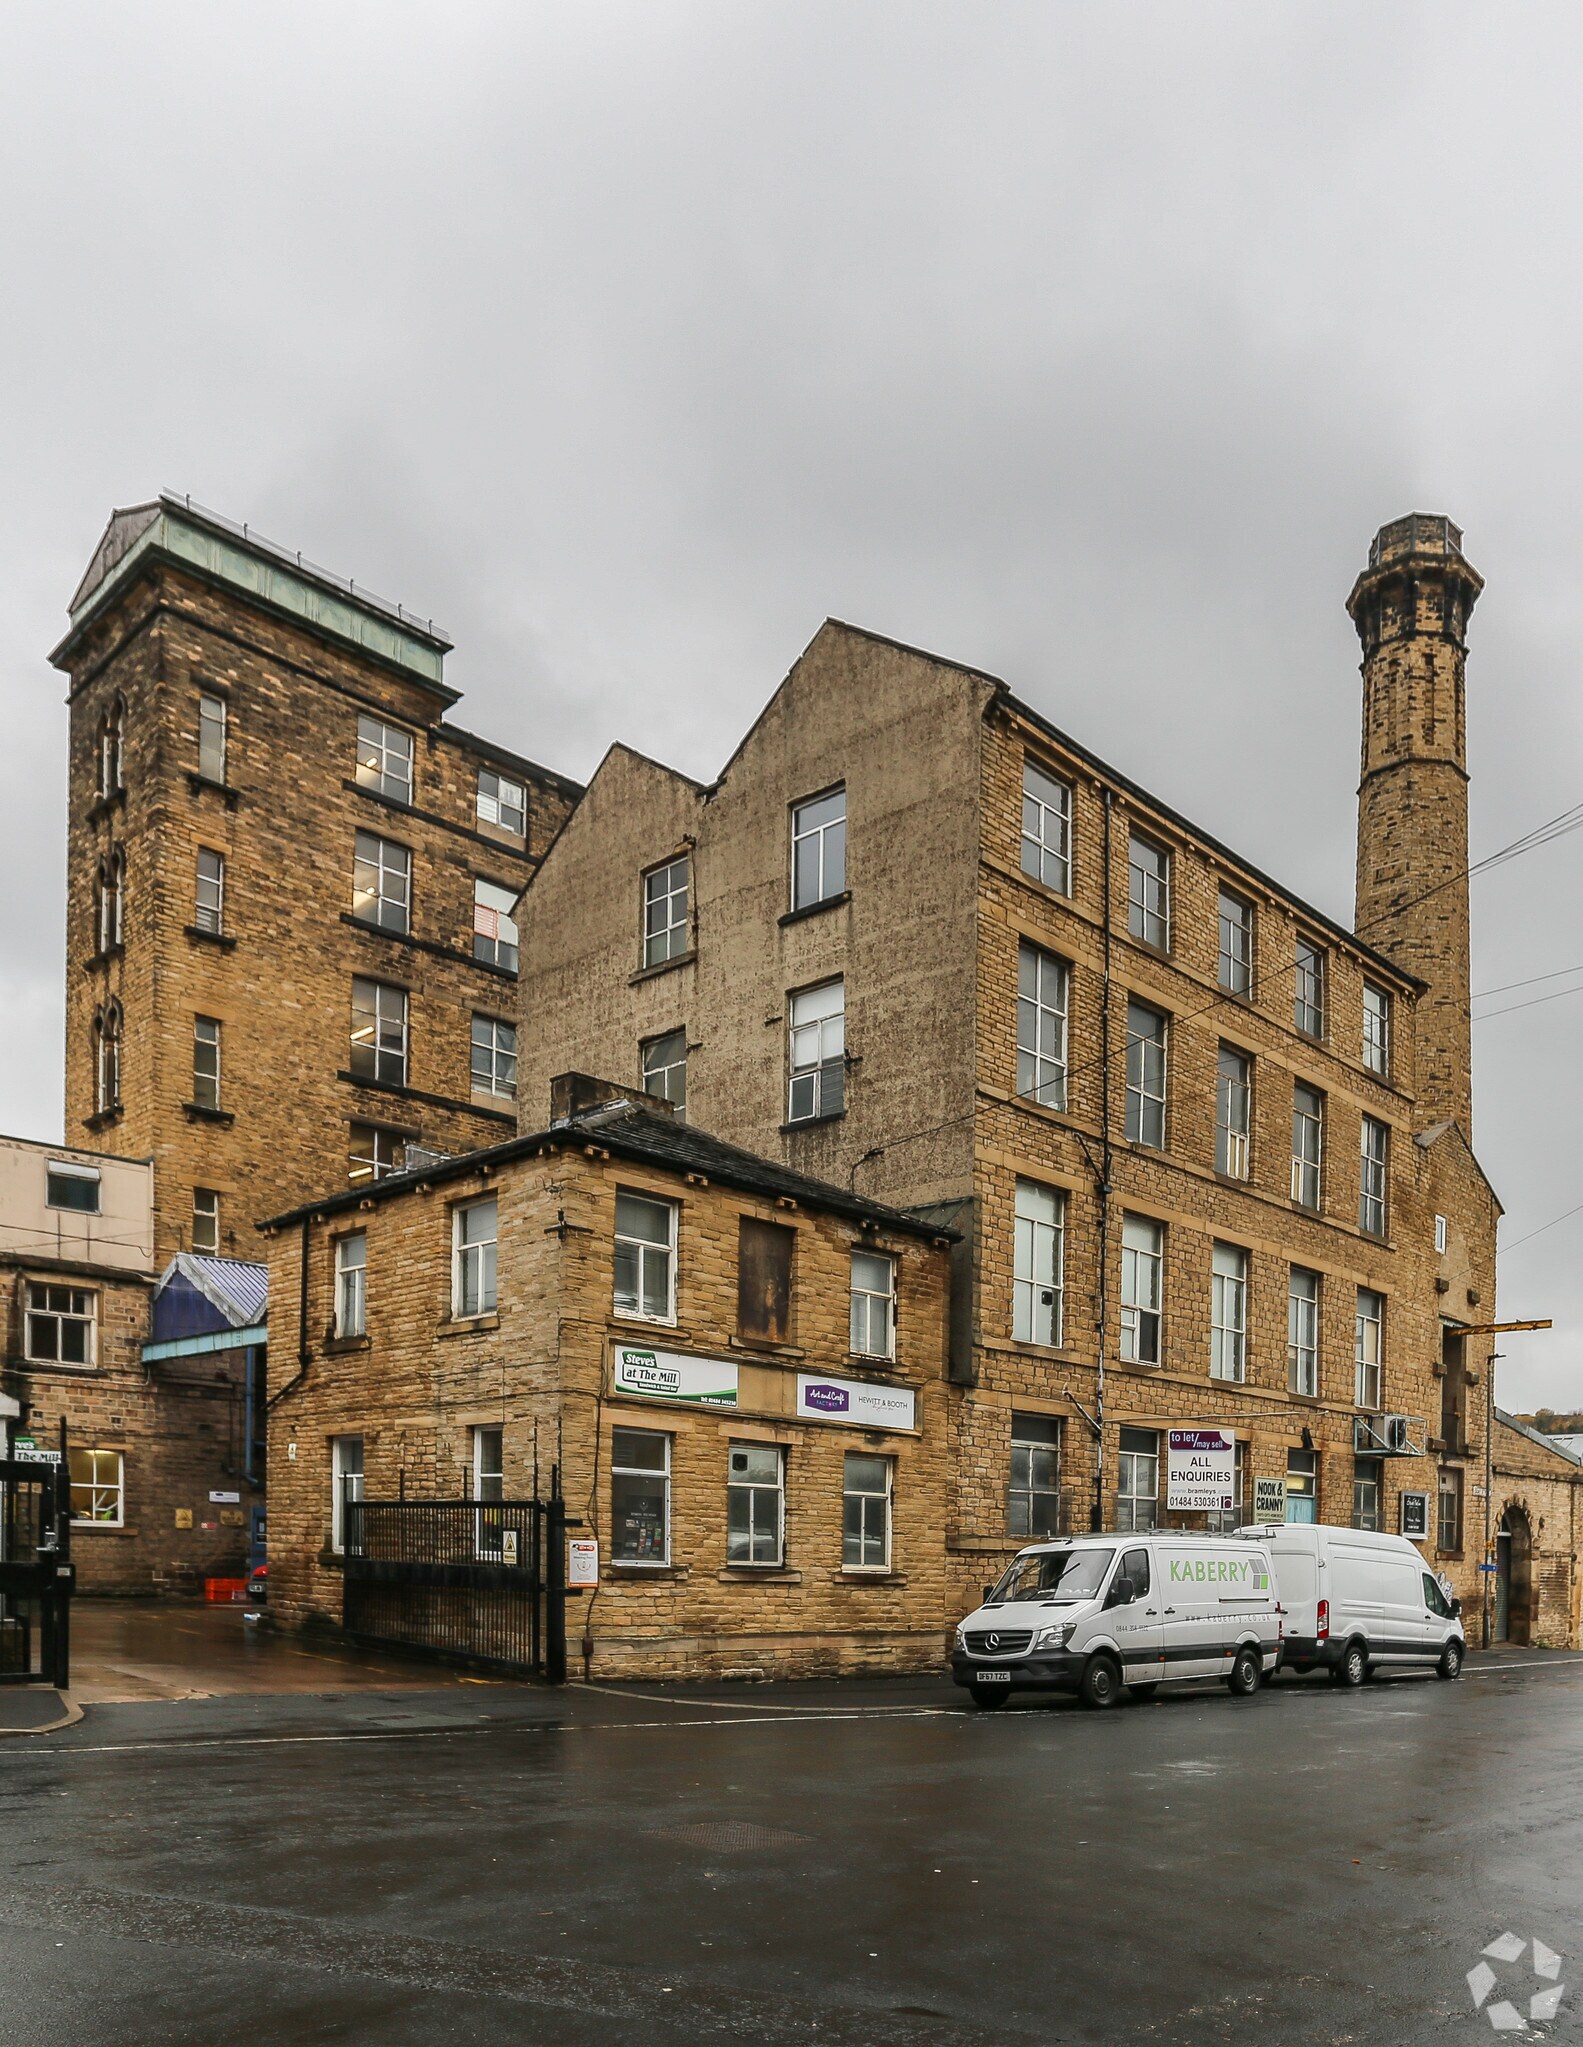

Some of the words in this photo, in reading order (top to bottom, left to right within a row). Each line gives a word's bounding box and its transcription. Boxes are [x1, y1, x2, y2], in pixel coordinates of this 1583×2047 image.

[625, 1353, 656, 1366] Steve's
[626, 1369, 637, 1378] at
[639, 1369, 657, 1381] The
[658, 1372, 678, 1384] Mill
[810, 1389, 820, 1398] Art
[820, 1391, 831, 1399] and
[831, 1391, 845, 1405] Craft
[858, 1396, 881, 1405] HEWITT
[887, 1400, 908, 1409] BOOTH
[1171, 1432, 1181, 1442] to
[1197, 1441, 1210, 1450] may
[1211, 1440, 1223, 1448] sell
[17, 1452, 36, 1461] The
[1190, 1456, 1212, 1467] ALL
[1170, 1470, 1231, 1482] ENQUIRIES
[1257, 1481, 1276, 1496] NOOK
[1276, 1481, 1283, 1496] &
[1169, 1496, 1192, 1507] 01484
[1193, 1496, 1220, 1507] 530361
[1256, 1496, 1284, 1511] CRANNY
[1170, 1560, 1249, 1582] KABERRY
[1185, 1613, 1270, 1624] www.kaberry.co.uk
